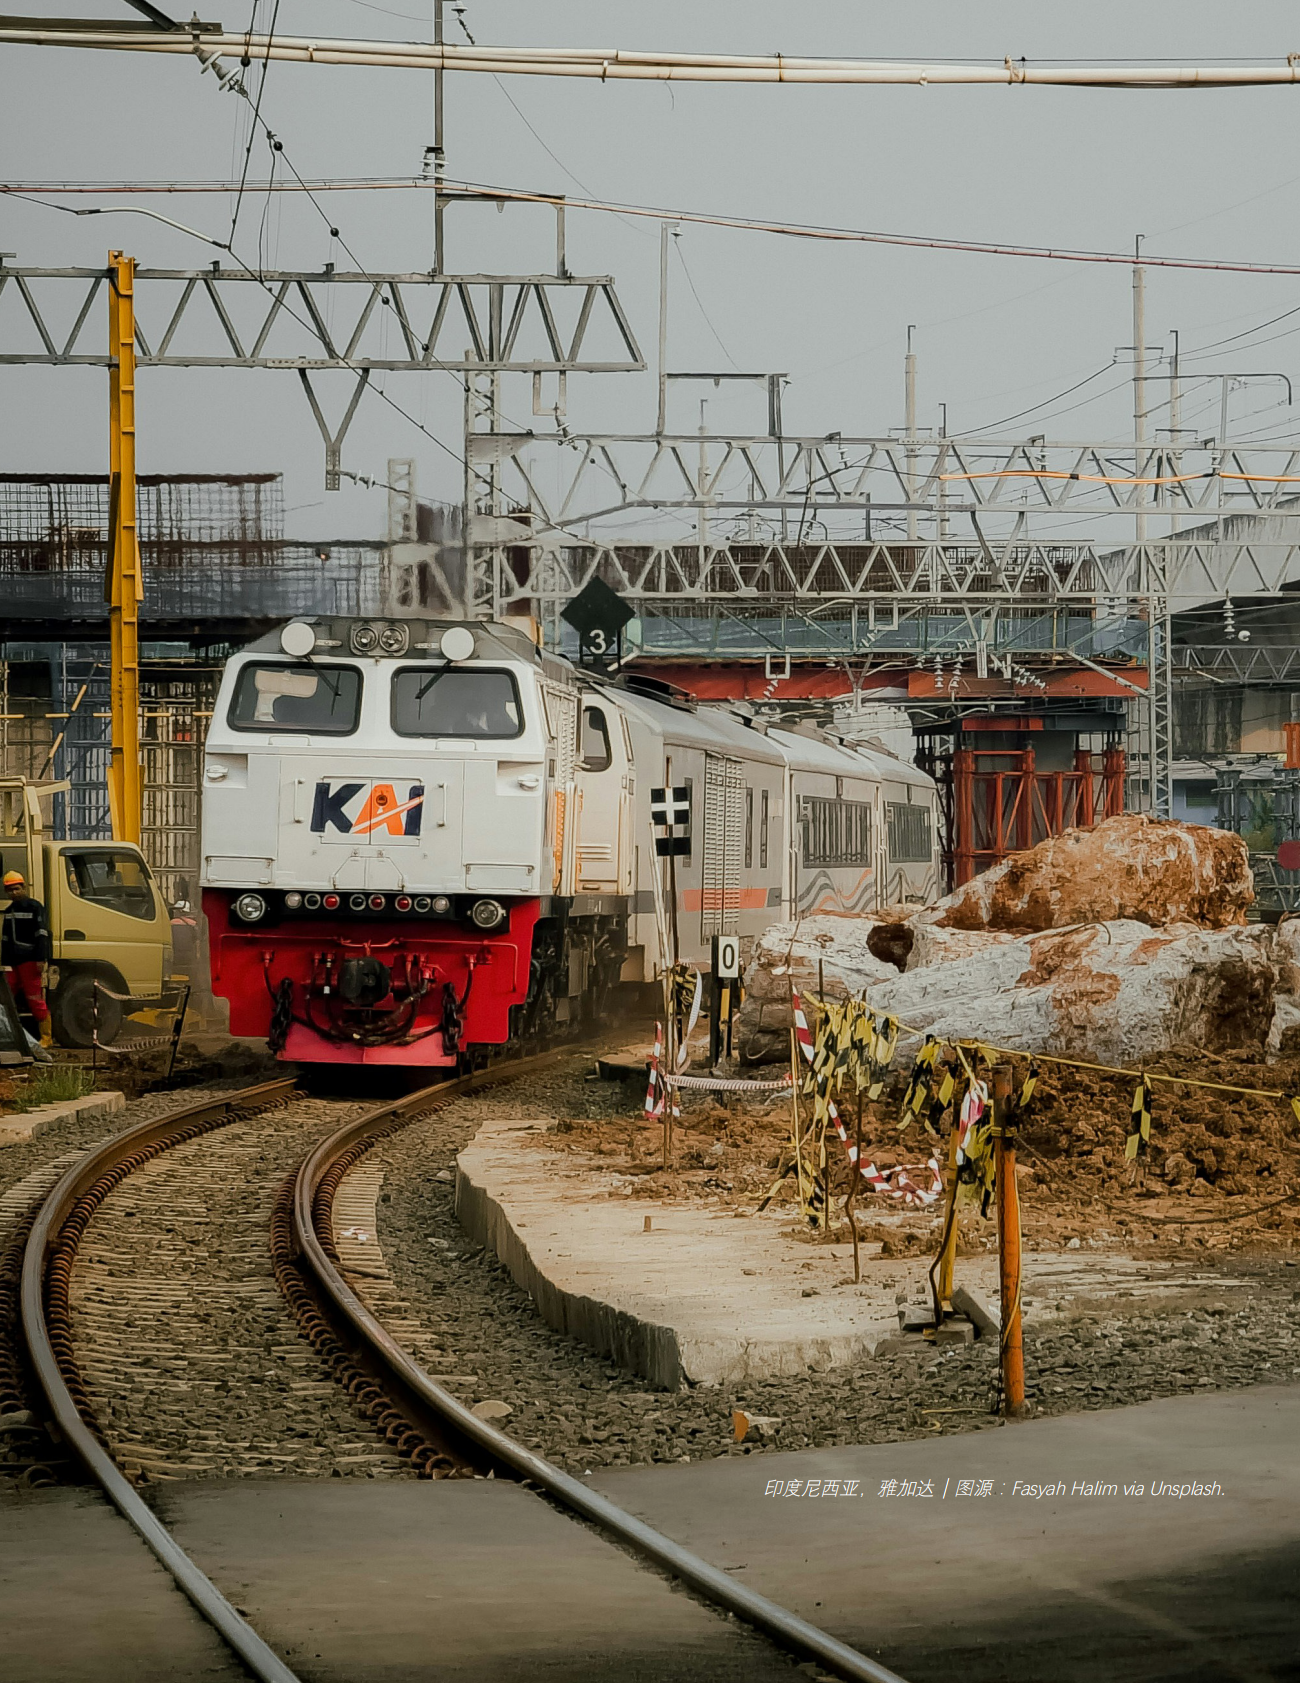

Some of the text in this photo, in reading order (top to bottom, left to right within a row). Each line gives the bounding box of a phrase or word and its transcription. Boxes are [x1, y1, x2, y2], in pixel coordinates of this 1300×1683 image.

[590, 629, 606, 654] 3
[310, 782, 424, 836] KAI
[723, 944, 735, 969] 0
